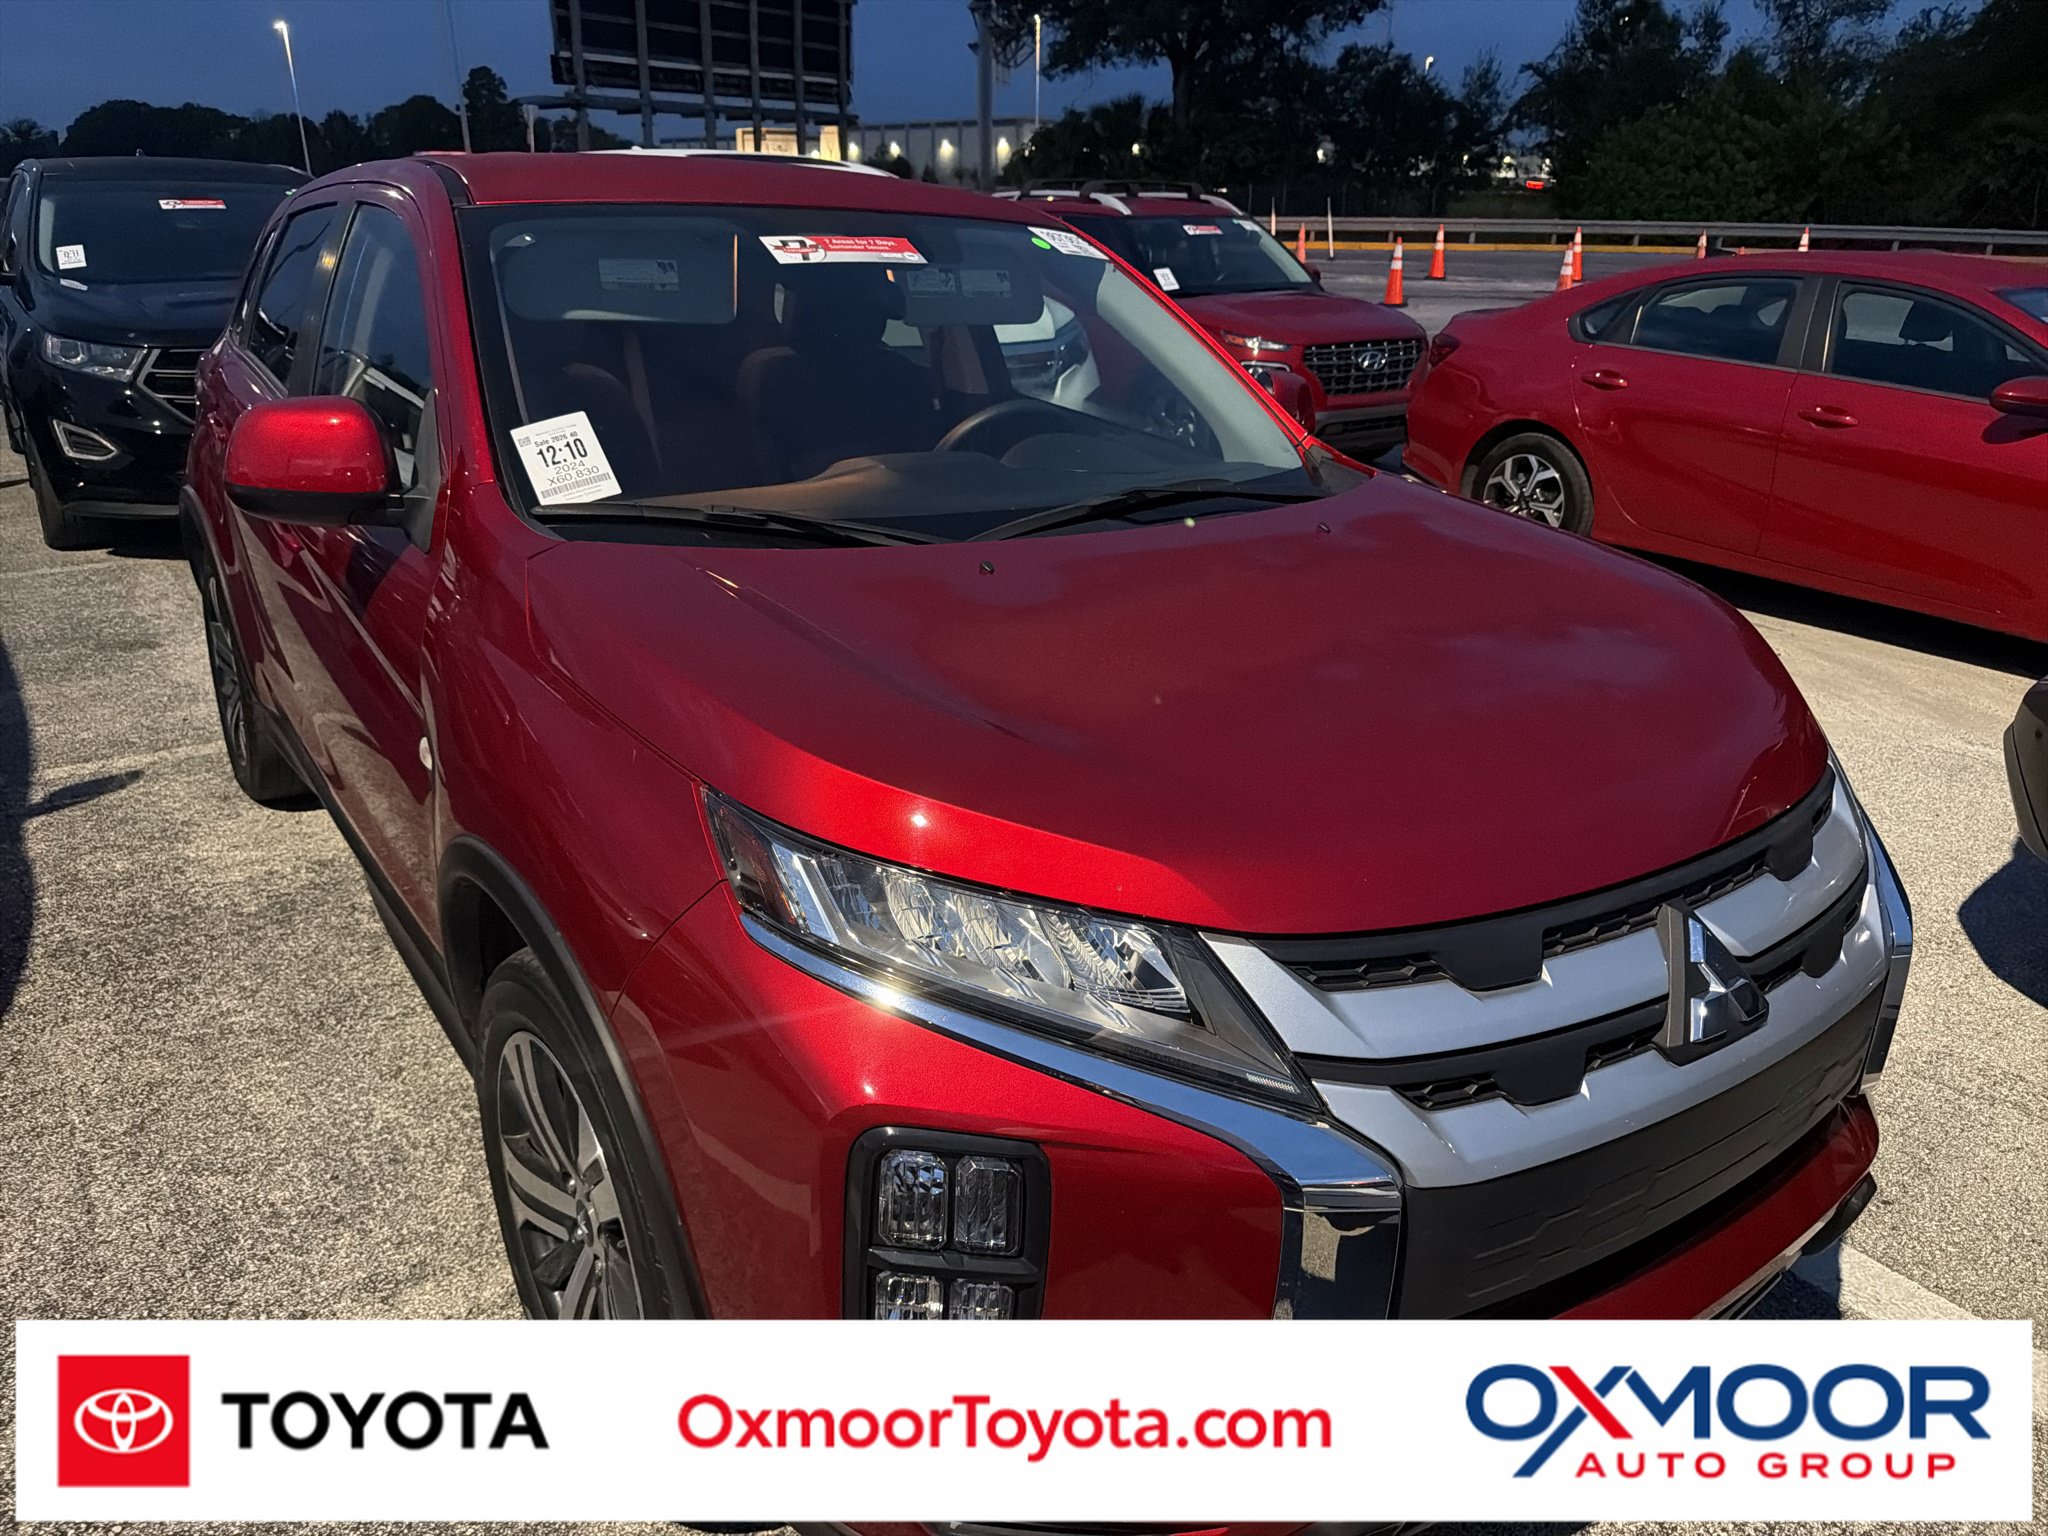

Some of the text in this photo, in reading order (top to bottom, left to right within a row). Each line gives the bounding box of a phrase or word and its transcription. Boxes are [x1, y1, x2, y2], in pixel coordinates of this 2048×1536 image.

[534, 439, 550, 448] Sale
[551, 433, 568, 444] 2026
[536, 438, 588, 468] 12:10
[554, 460, 586, 475] 2024
